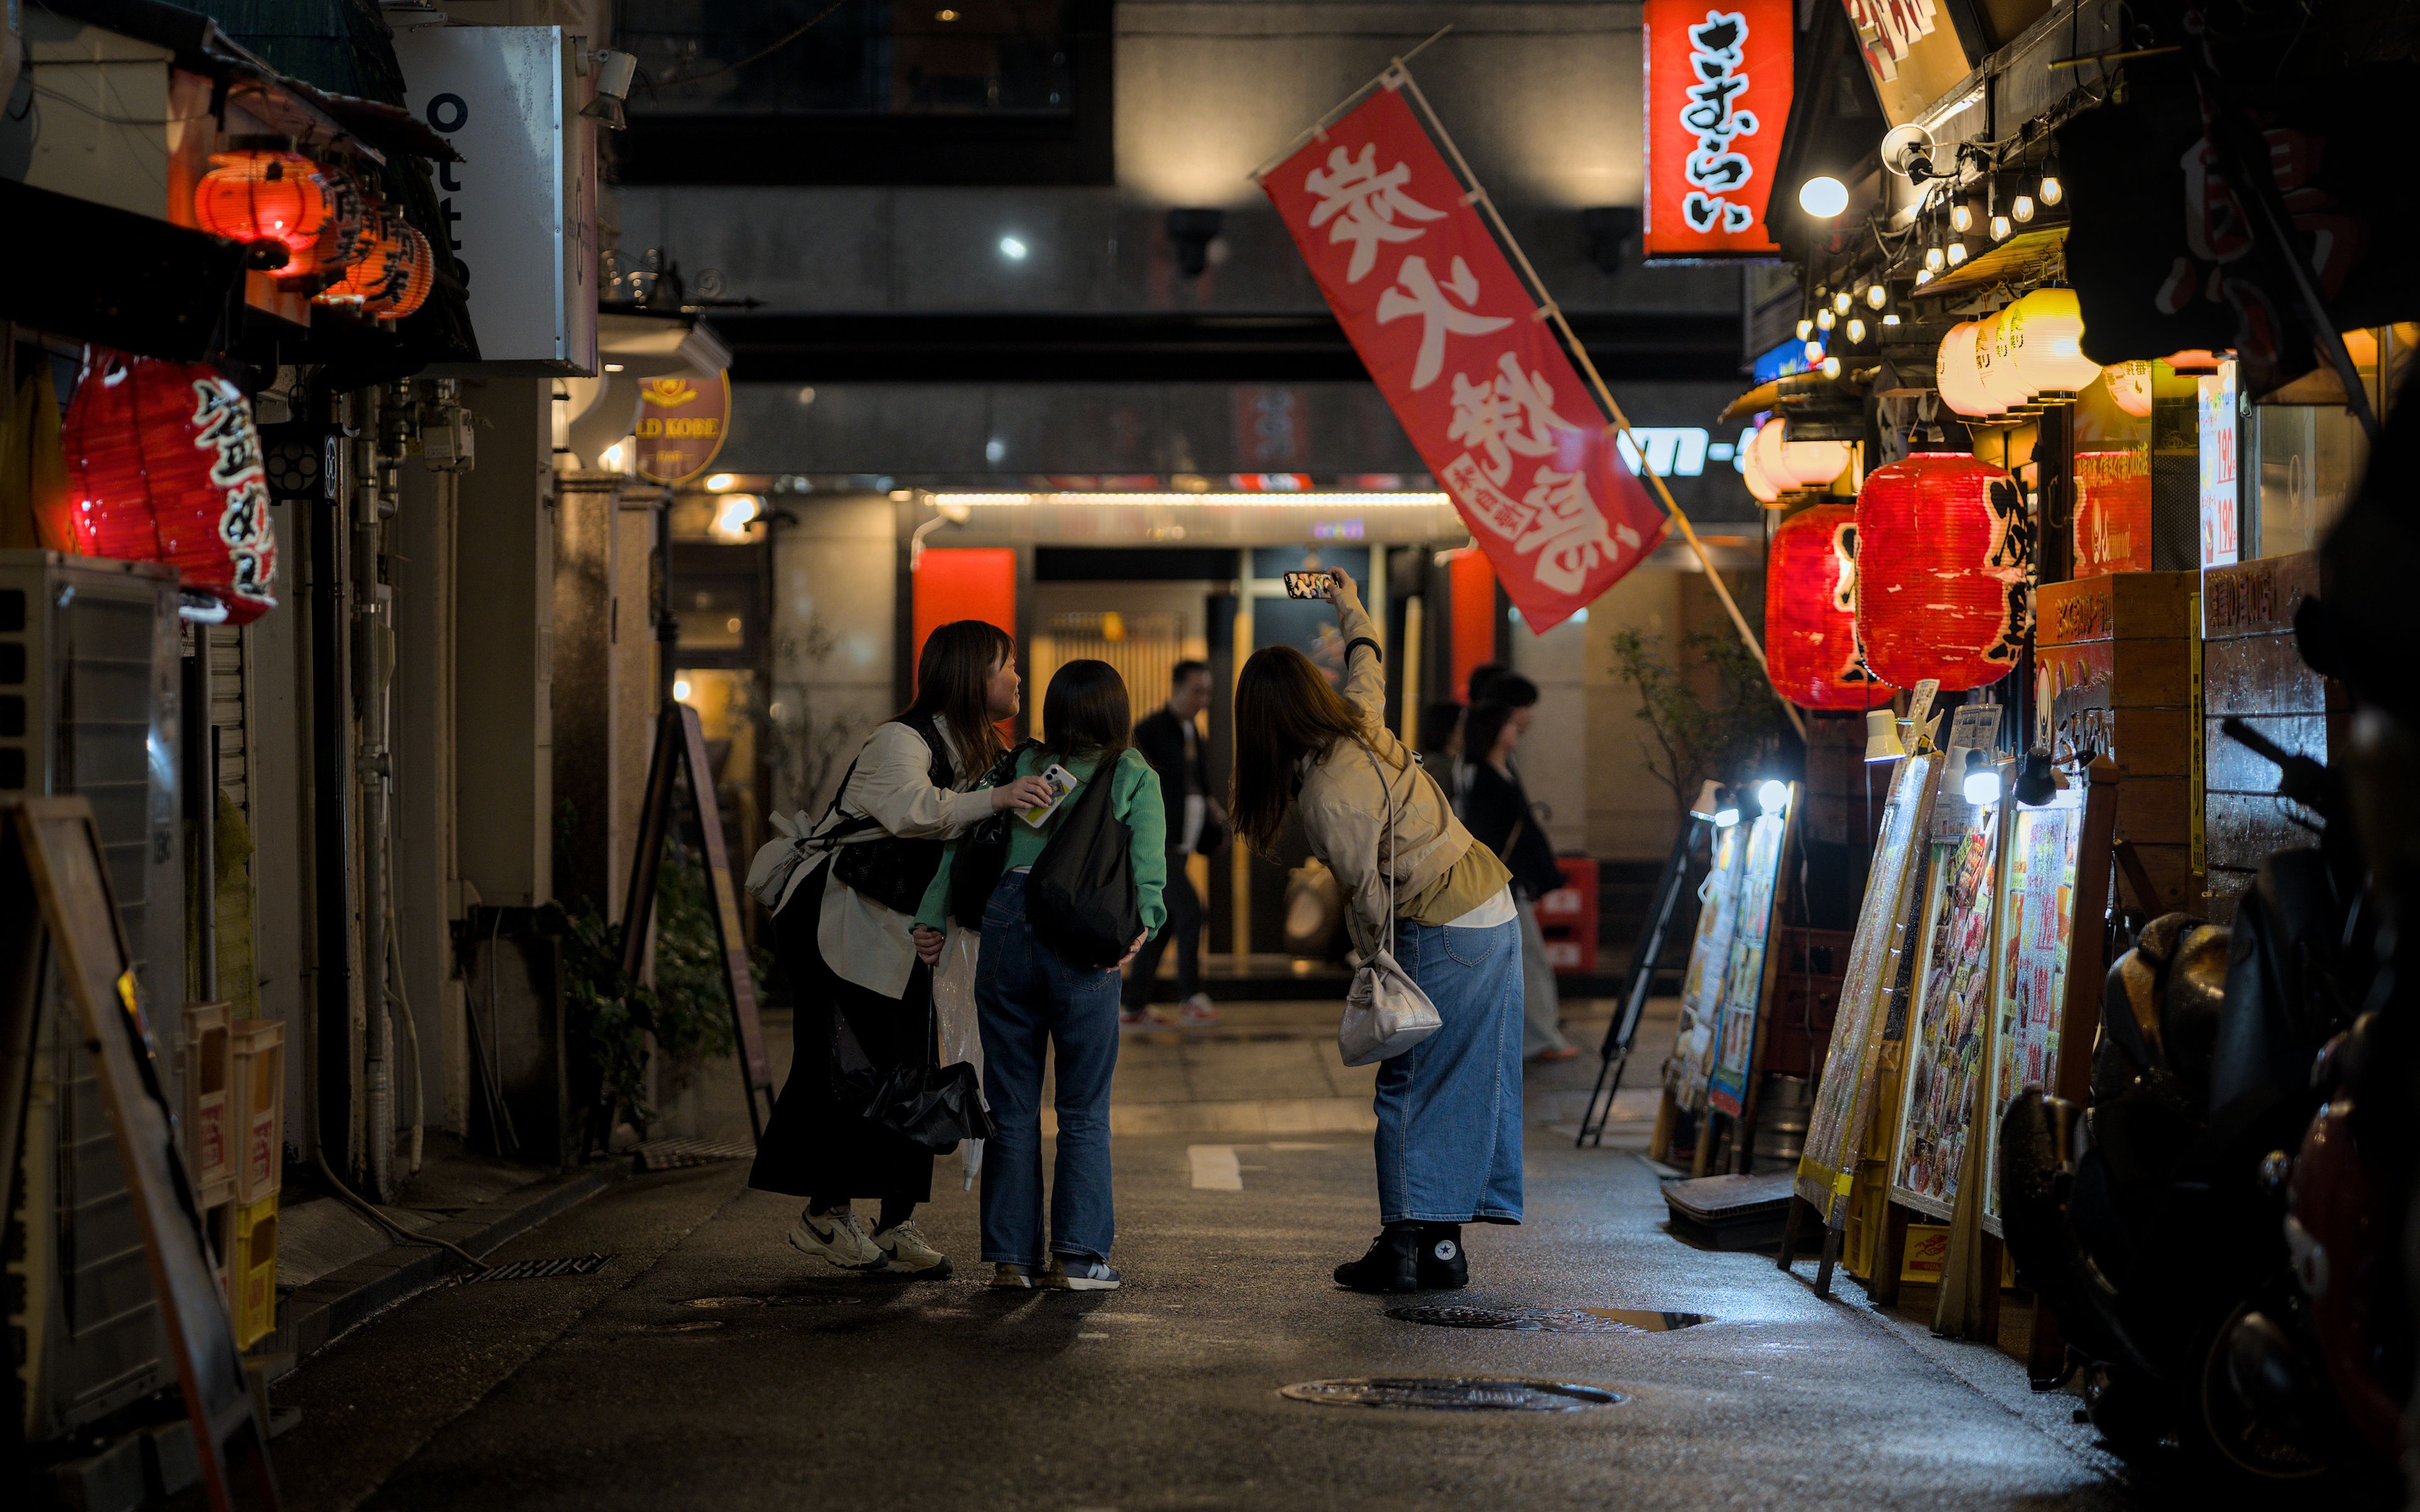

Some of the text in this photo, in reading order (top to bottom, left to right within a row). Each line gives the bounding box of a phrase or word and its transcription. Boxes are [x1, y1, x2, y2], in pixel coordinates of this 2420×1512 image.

[1681, 9, 1759, 233] さむらい
[664, 418, 720, 440] KOBE
